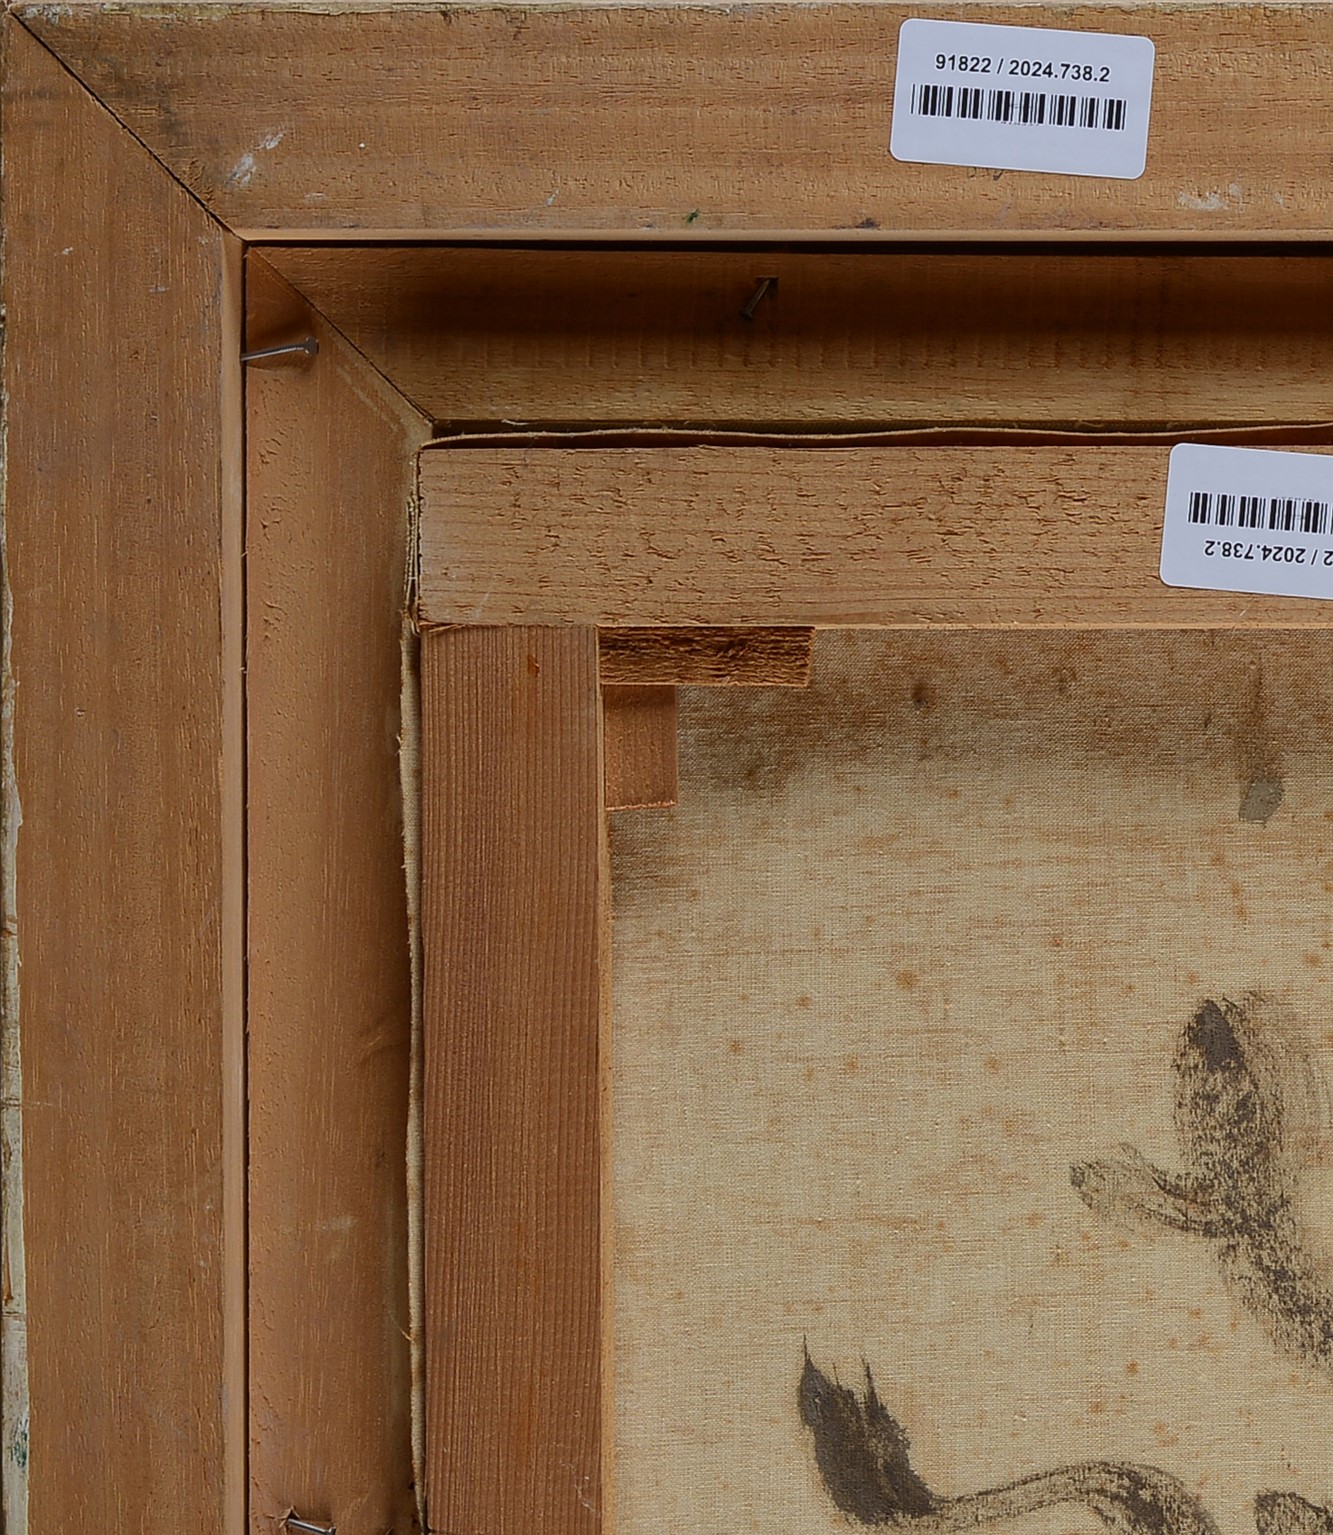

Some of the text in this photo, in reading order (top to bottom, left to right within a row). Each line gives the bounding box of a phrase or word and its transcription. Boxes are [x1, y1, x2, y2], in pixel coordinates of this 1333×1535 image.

[935, 53, 1111, 83] 91822 / 2024.738.2
[1204, 540, 1304, 564] 2024.738.2
[1310, 549, 1317, 566] /
